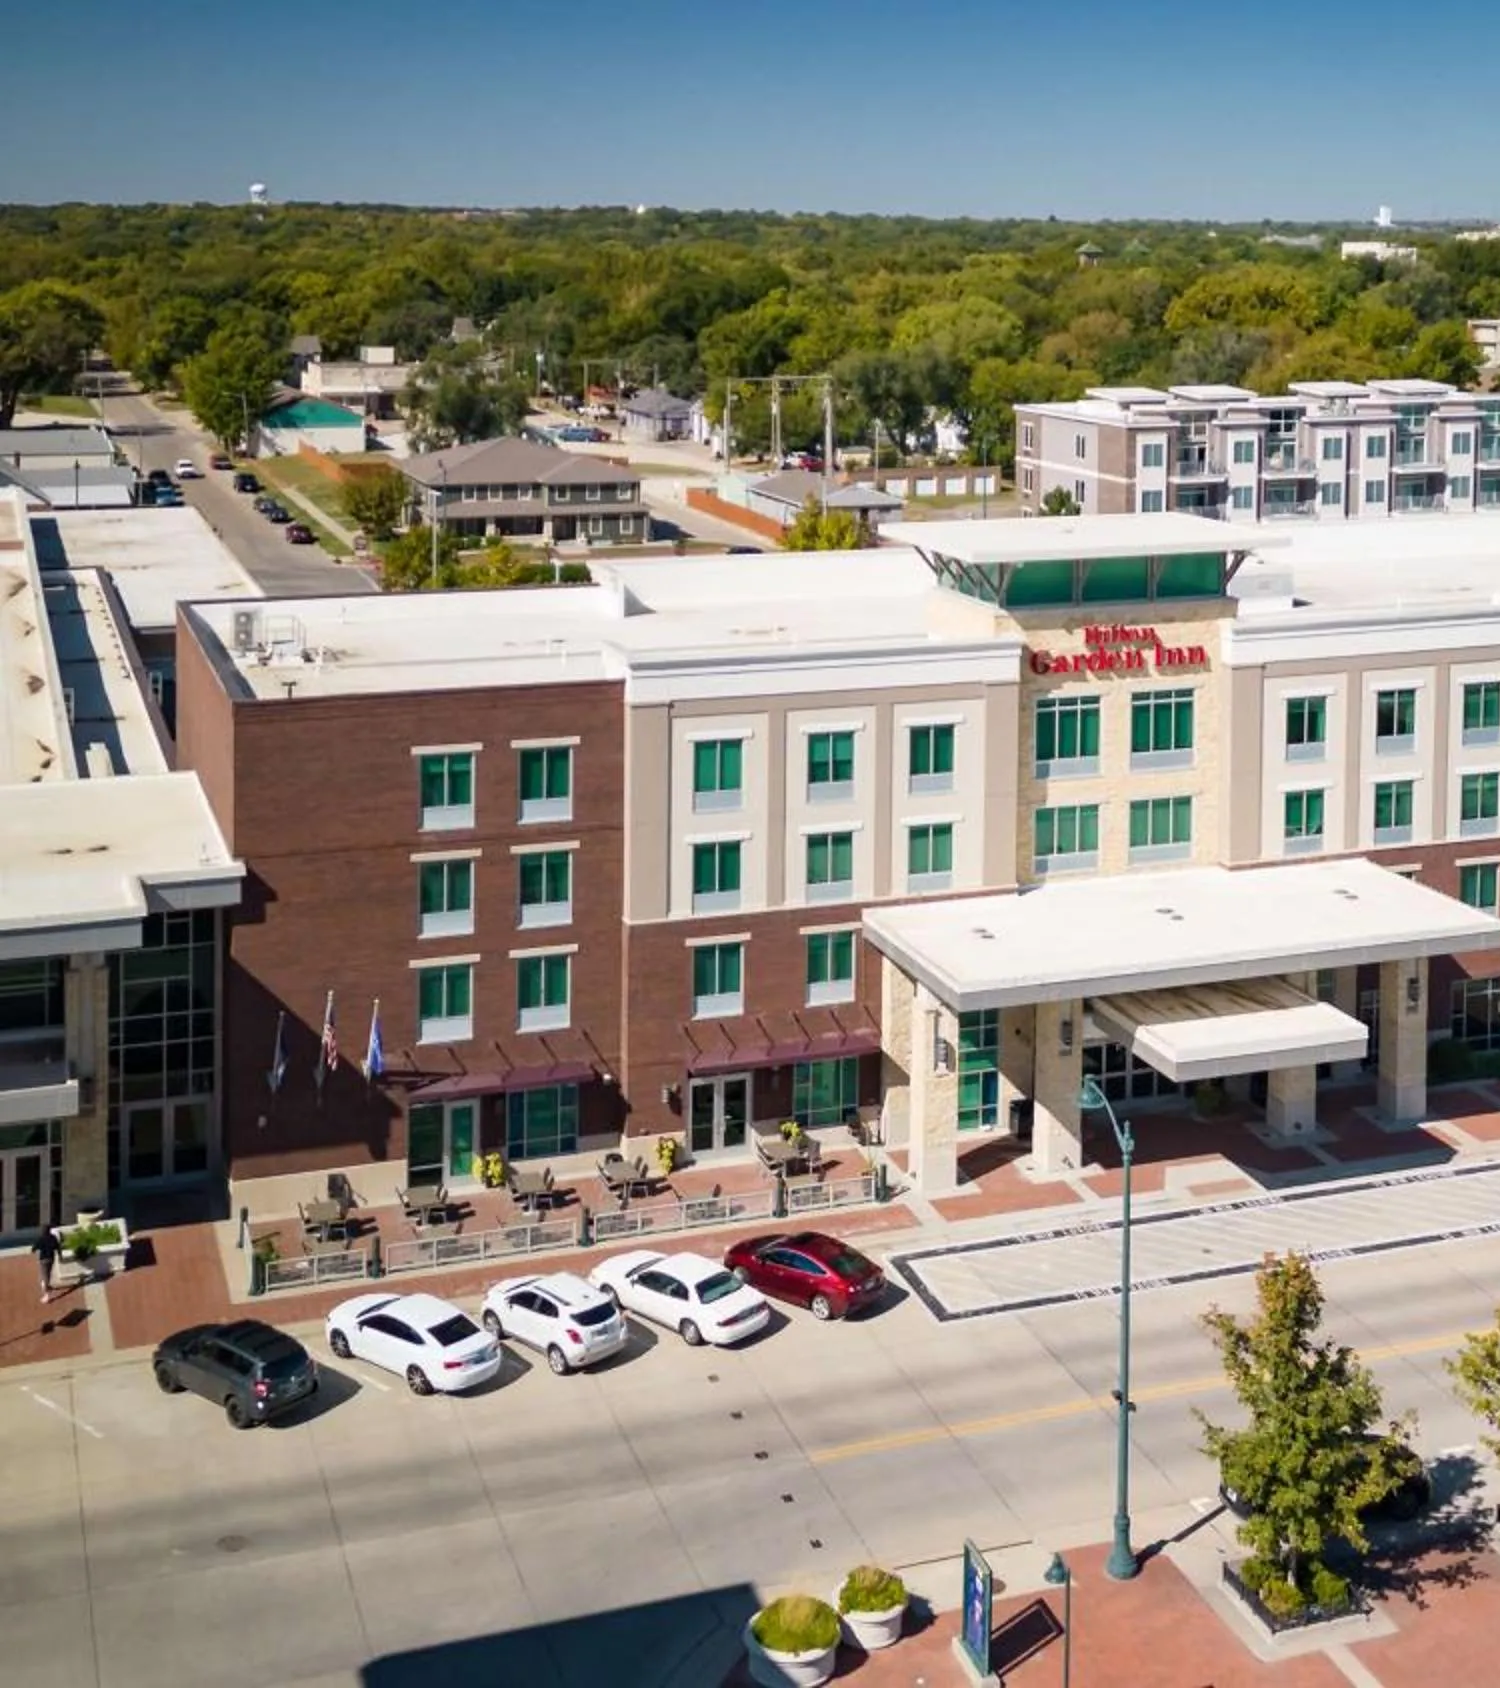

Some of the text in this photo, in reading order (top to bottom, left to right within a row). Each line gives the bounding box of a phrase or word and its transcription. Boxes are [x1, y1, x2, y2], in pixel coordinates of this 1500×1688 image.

[1084, 624, 1157, 644] Hilton
[1030, 644, 1207, 674] Garden Inn
